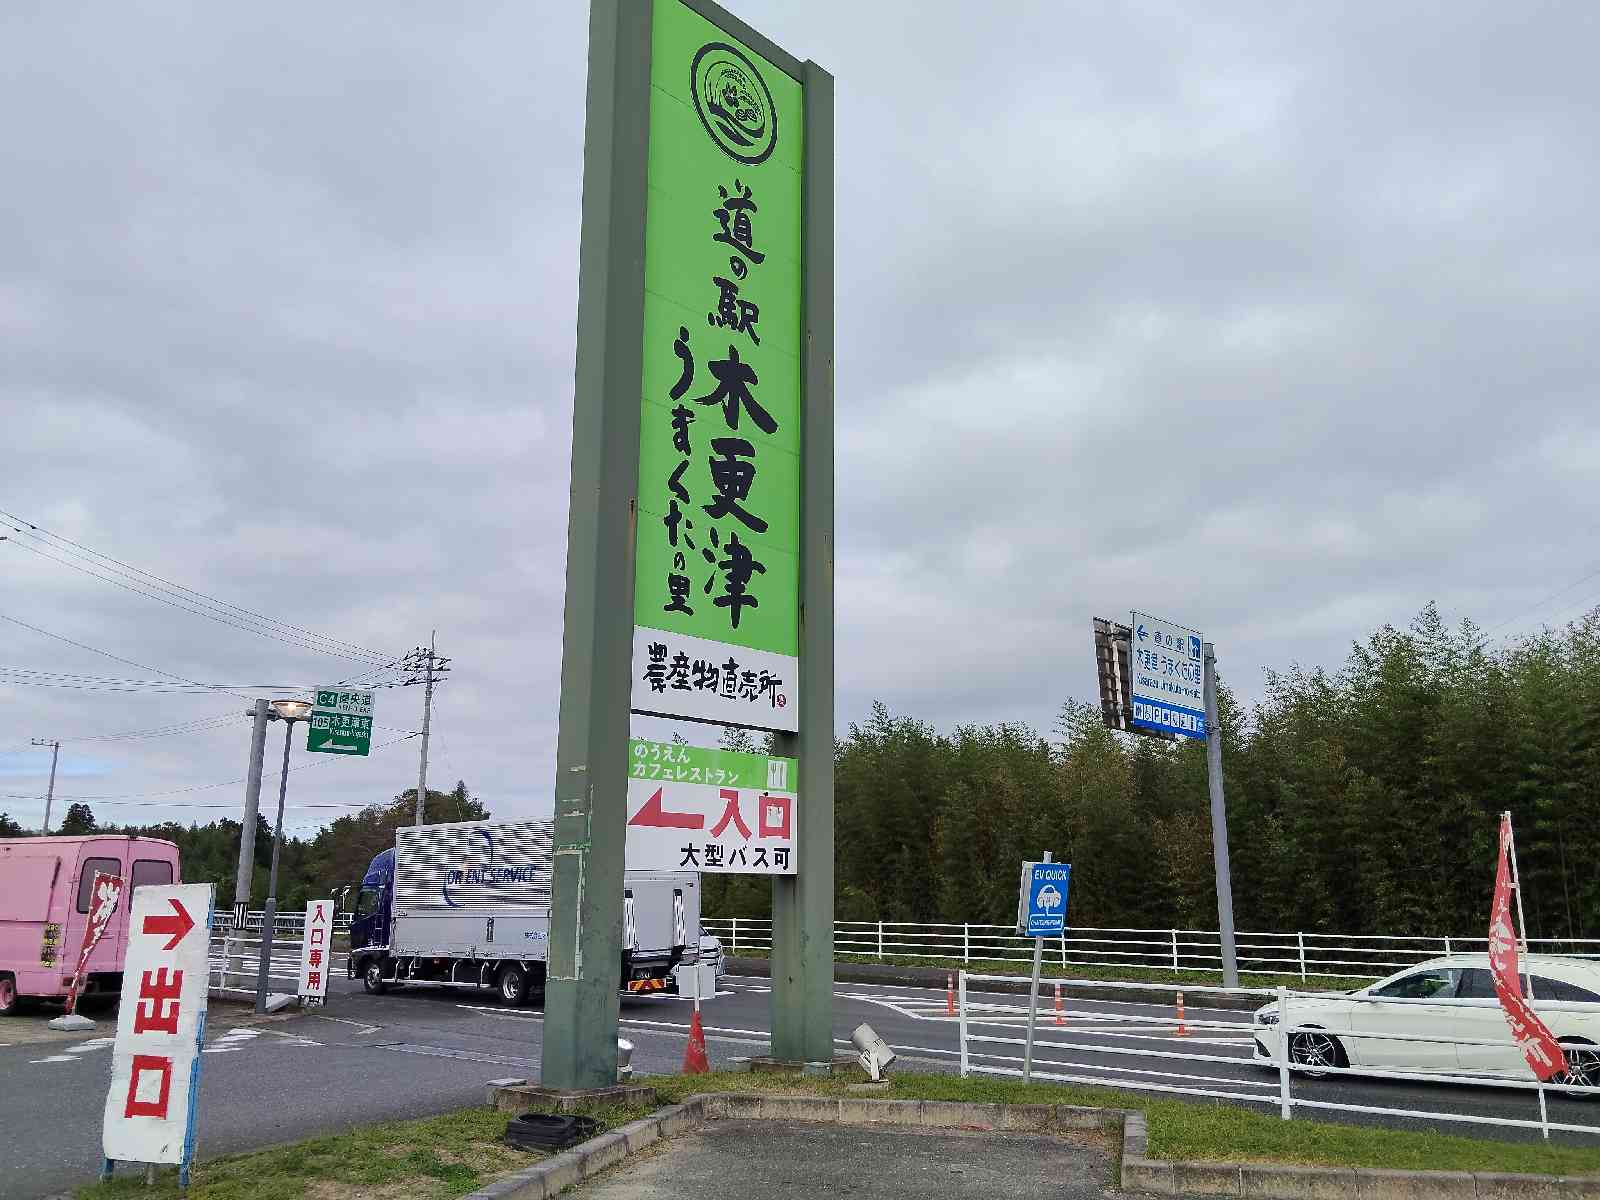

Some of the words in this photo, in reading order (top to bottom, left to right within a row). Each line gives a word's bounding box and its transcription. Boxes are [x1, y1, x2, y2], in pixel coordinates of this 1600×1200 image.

[663, 325, 697, 617] うまくたの里
[643, 641, 783, 709] 農産物直売所
[319, 693, 336, 705] C4
[312, 716, 330, 728] 105
[634, 742, 691, 763] のうえん
[633, 762, 740, 785] カフェレストラン
[709, 788, 792, 842] 入口
[679, 842, 791, 871] 大型バス可
[1034, 869, 1045, 880] EV
[1045, 869, 1067, 881] QUICK
[306, 904, 326, 990] 入口専用
[123, 967, 184, 1121] 出口
